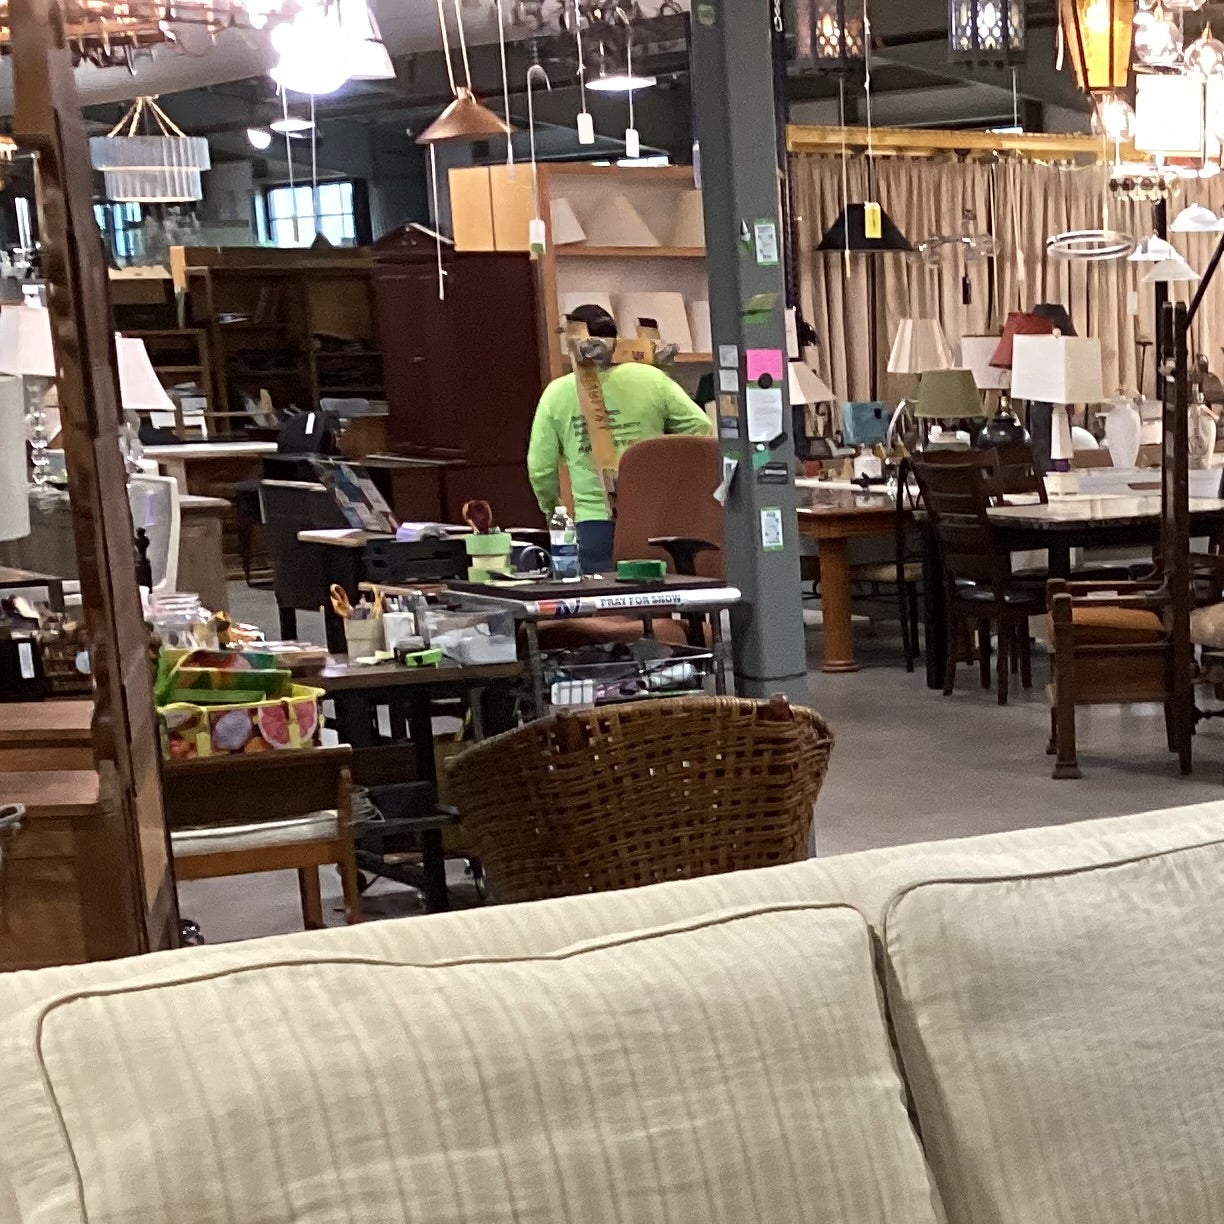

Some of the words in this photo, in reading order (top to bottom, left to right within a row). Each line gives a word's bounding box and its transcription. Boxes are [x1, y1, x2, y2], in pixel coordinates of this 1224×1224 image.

[600, 597, 626, 607] PRAY
[628, 596, 650, 606] FOR
[651, 594, 681, 604] SNOW
